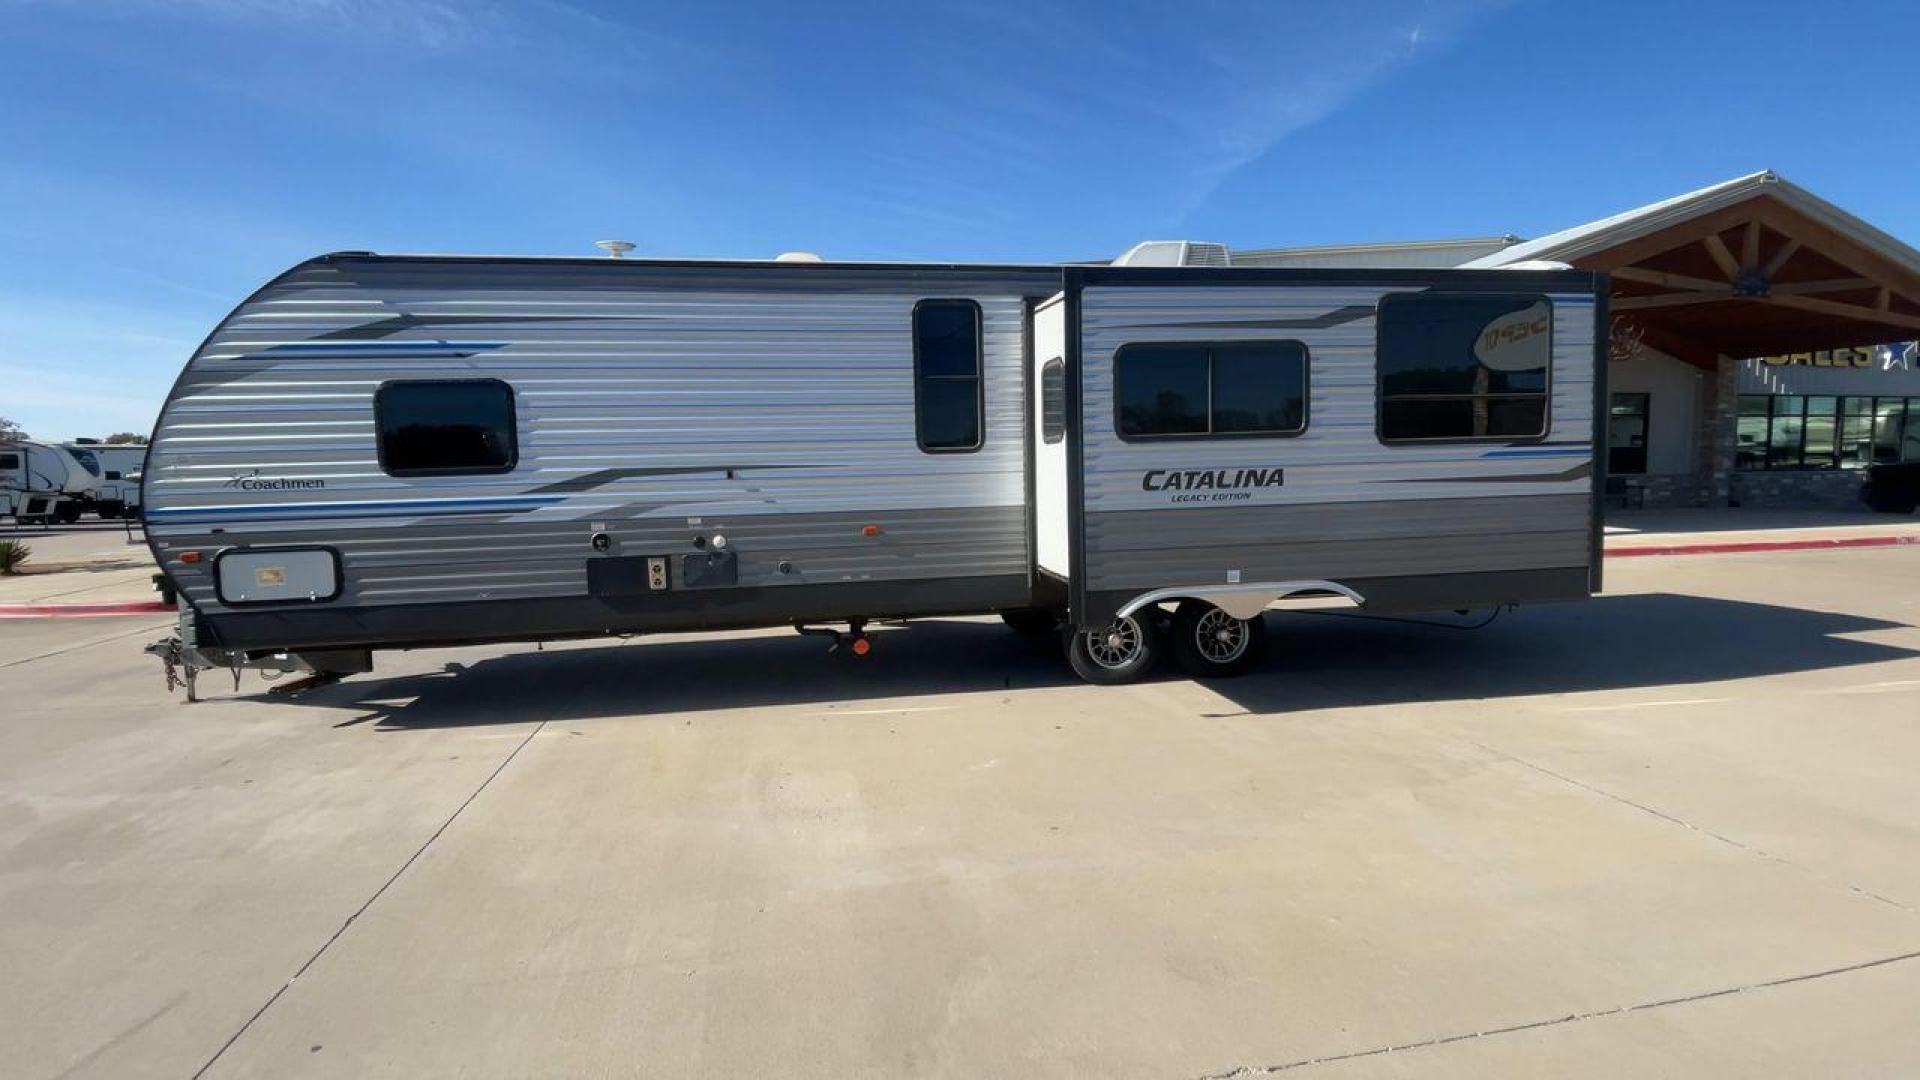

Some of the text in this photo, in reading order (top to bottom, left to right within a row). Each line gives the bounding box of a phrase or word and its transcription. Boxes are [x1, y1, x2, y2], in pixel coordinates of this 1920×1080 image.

[242, 478, 325, 490] Coachmen
[1142, 468, 1285, 491] CATALINA
[1171, 492, 1252, 503] LEGACY EDITION
